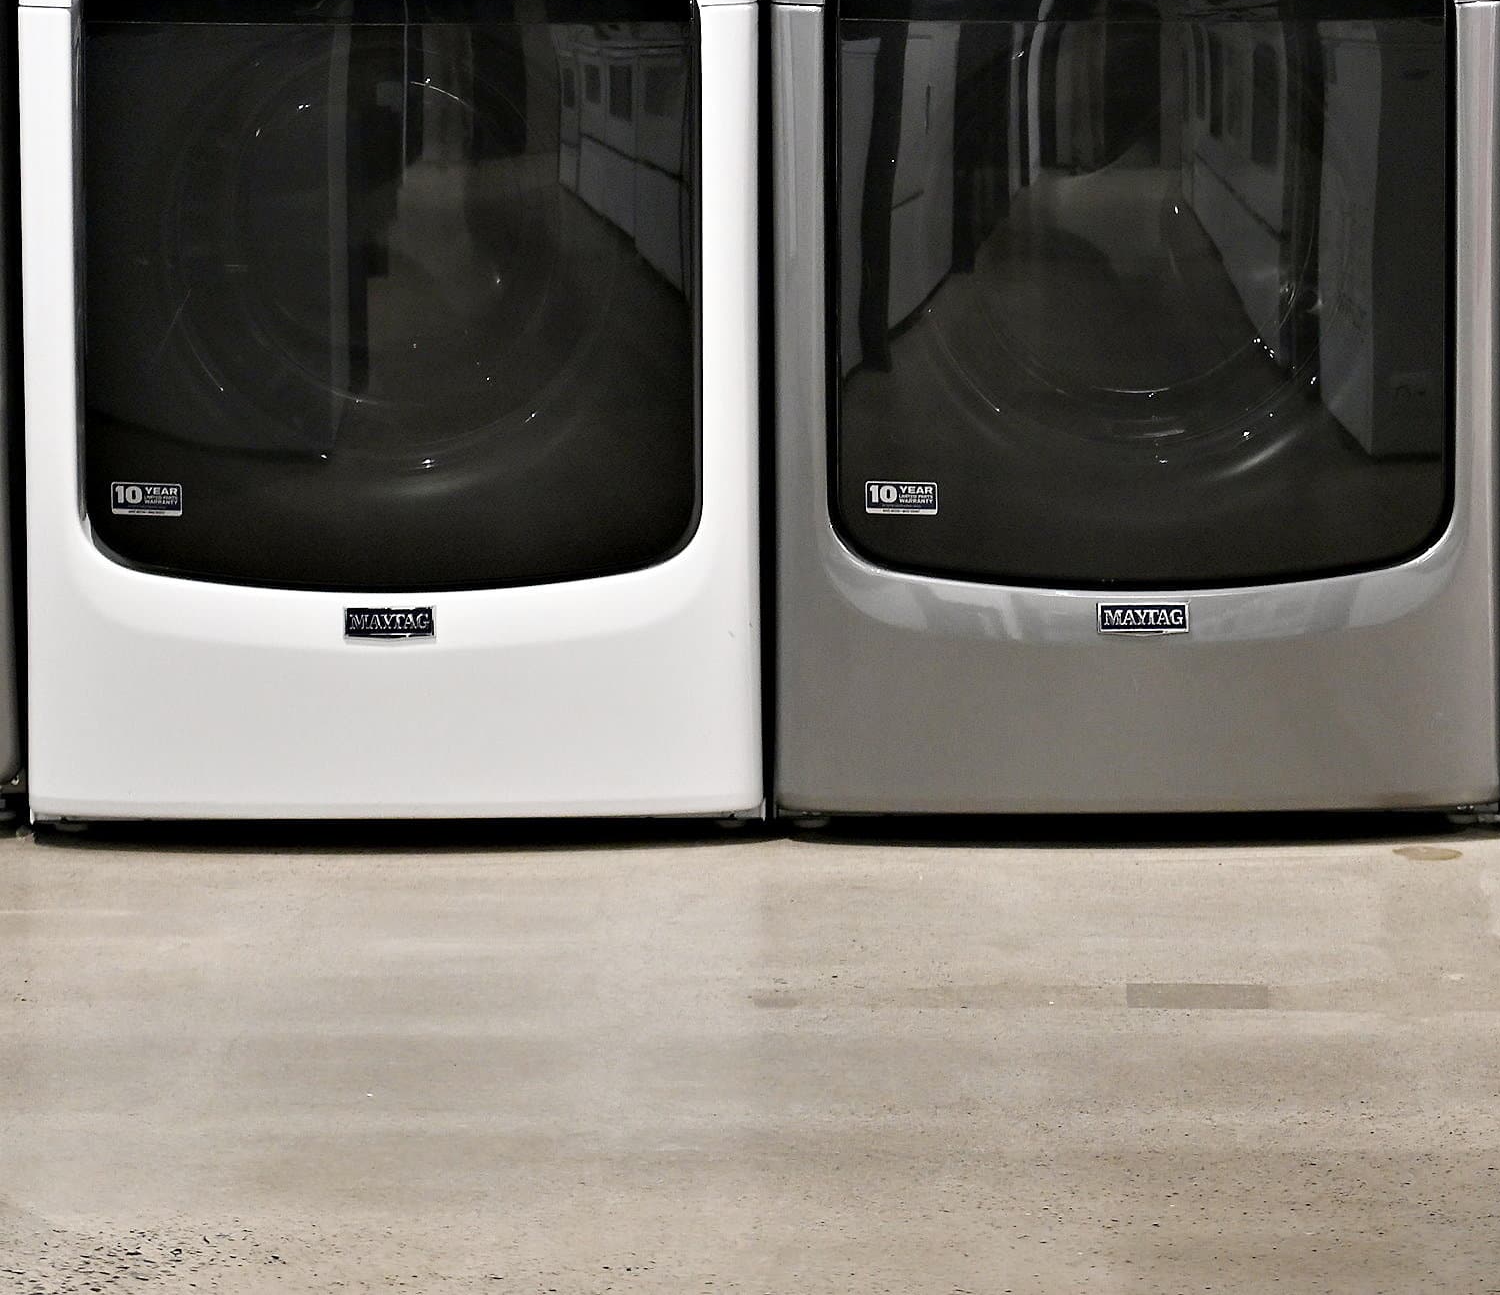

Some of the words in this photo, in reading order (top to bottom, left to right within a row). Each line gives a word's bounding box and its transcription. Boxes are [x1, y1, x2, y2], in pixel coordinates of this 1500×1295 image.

[115, 486, 142, 503] 10
[145, 487, 177, 495] YEAR
[870, 485, 897, 503] 10
[900, 486, 933, 494] YEAR
[350, 613, 429, 630] MAYTAG
[1104, 609, 1183, 626] MAYTAG
